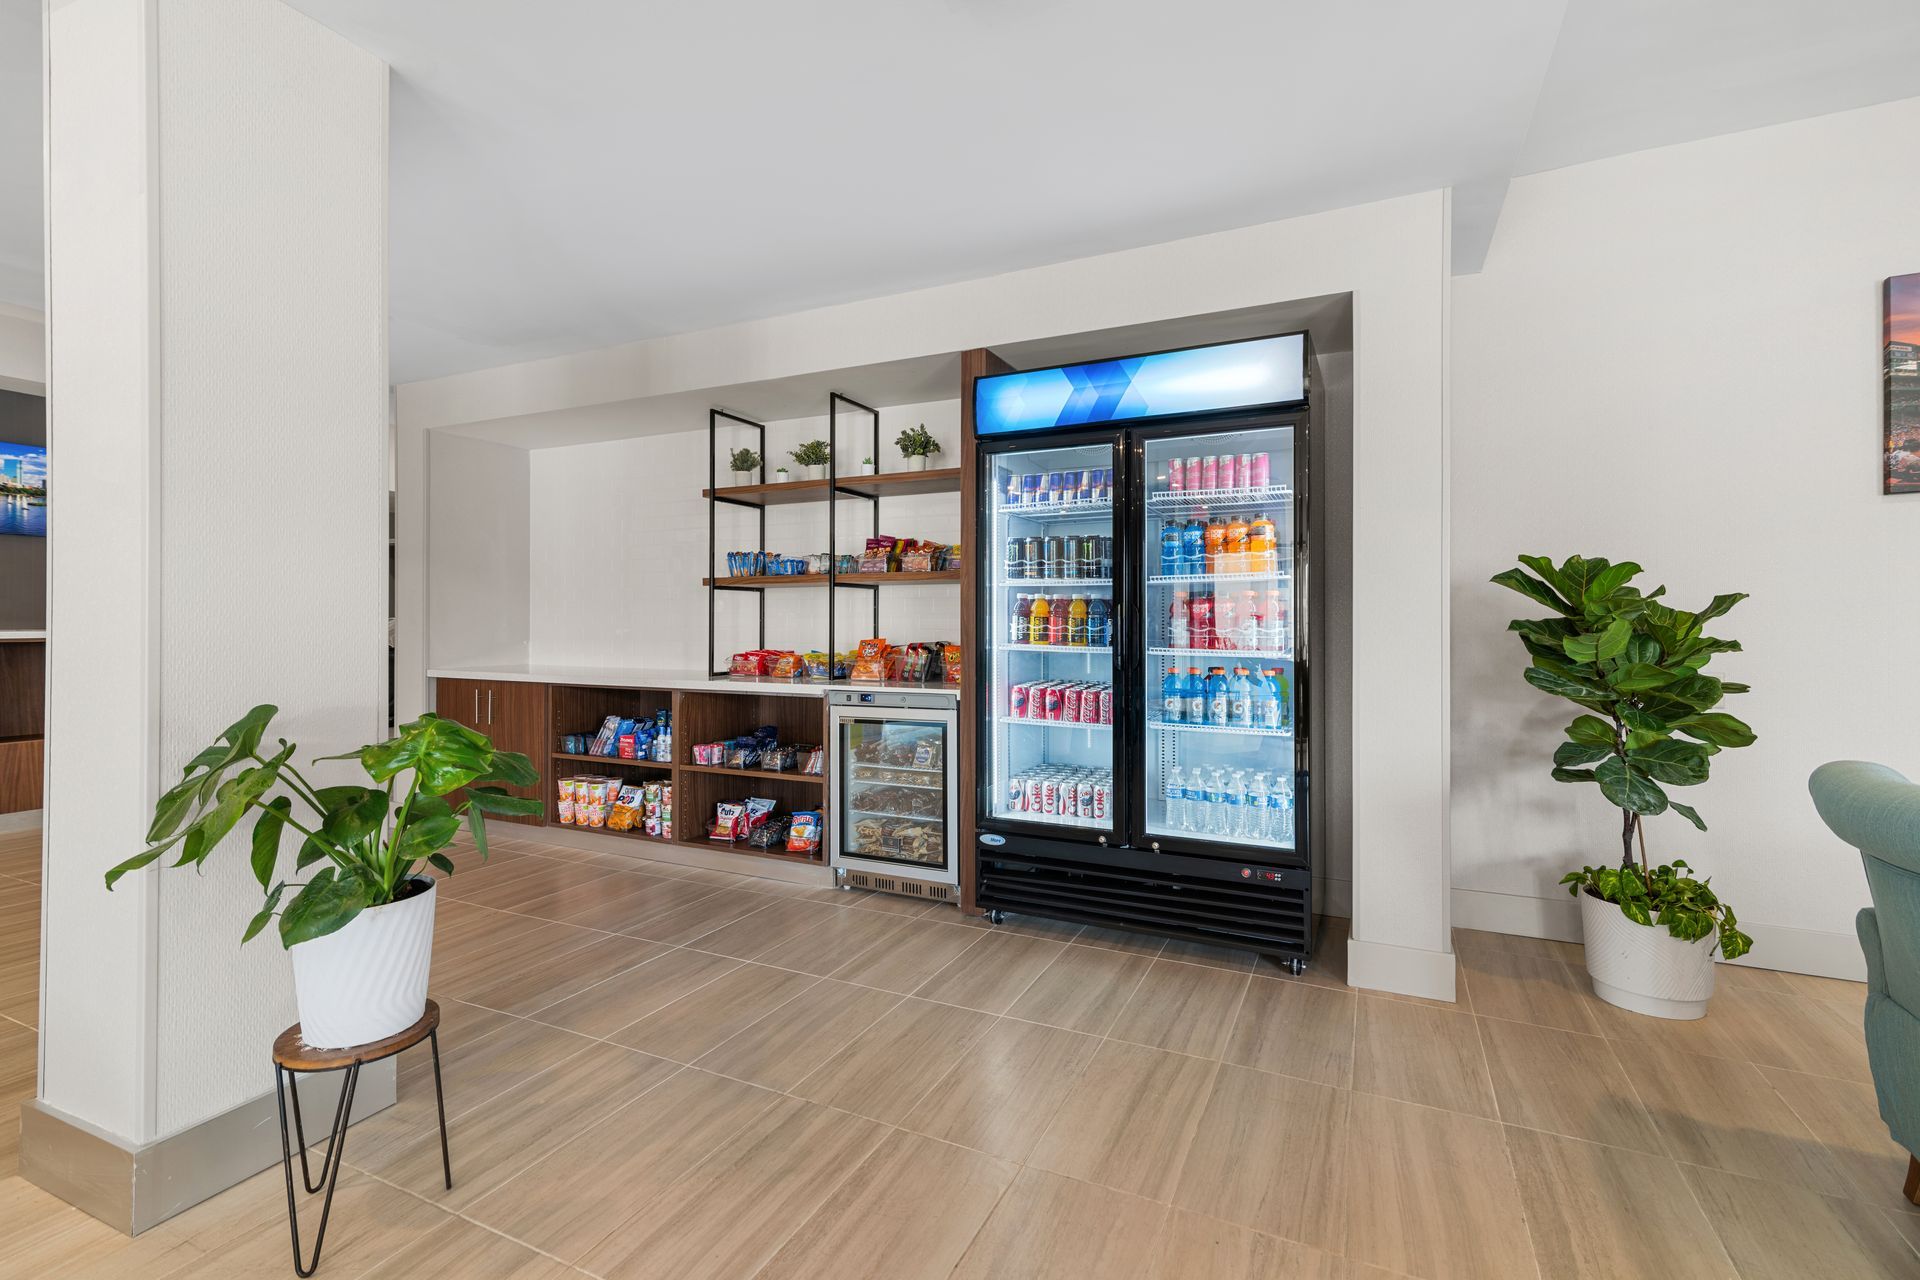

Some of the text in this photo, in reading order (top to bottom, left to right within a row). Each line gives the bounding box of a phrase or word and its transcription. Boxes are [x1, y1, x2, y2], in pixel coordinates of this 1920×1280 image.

[1031, 783, 1041, 812] Coke
[1044, 784, 1054, 814] Coke
[1095, 789, 1104, 818] Coke
